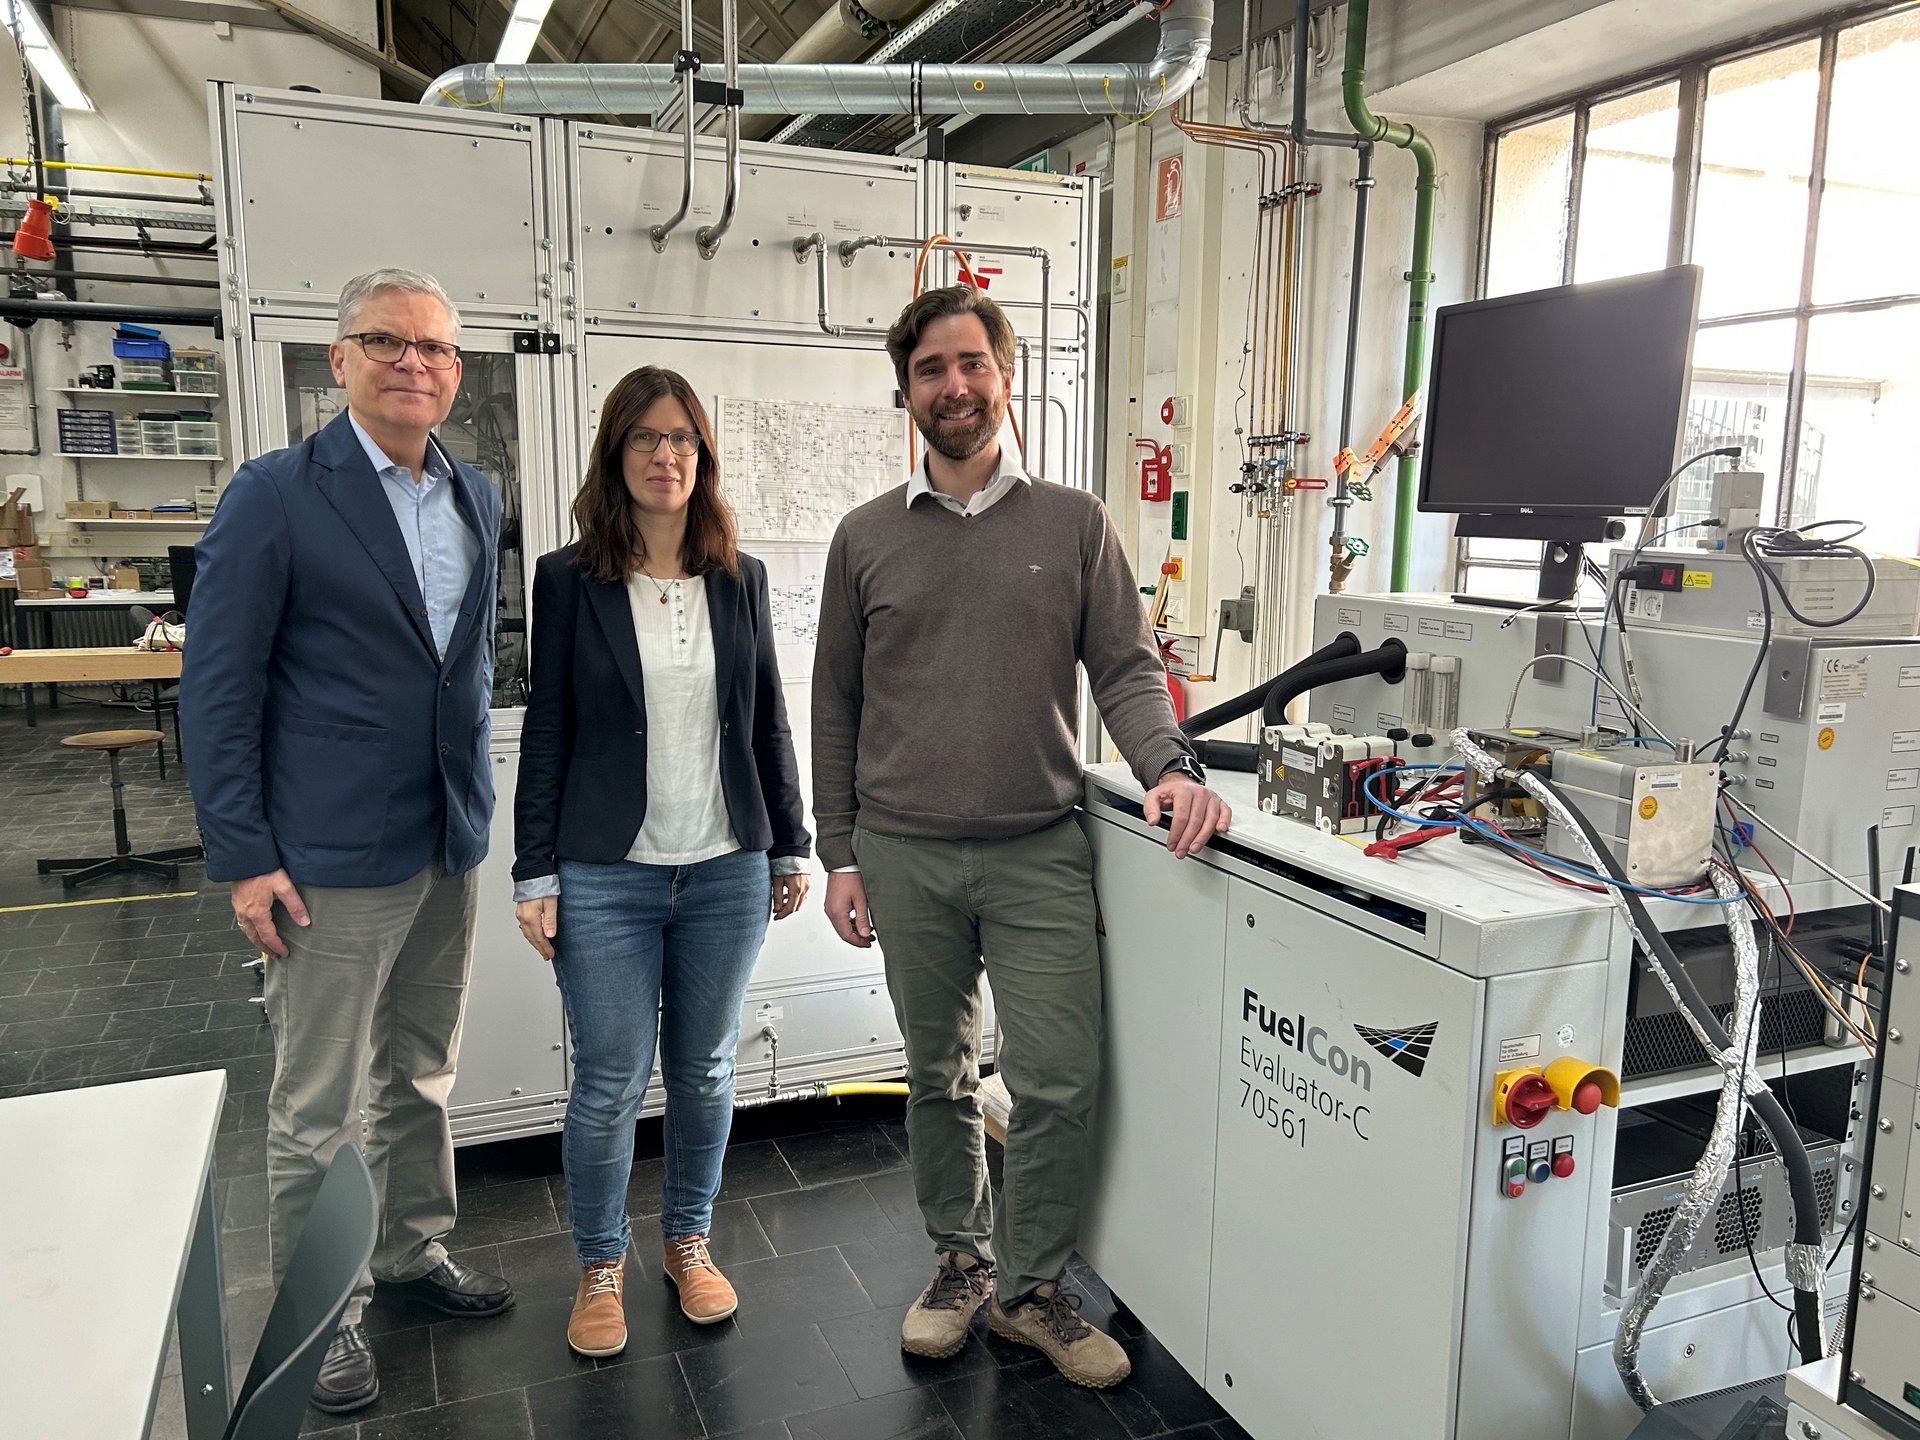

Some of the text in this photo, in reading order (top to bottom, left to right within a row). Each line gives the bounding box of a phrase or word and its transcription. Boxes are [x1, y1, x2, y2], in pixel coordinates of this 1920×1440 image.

[1240, 1035, 1371, 1141] Evaluator-C
[1242, 987, 1373, 1092] FuelCon
[1239, 1077, 1307, 1148] 70561
